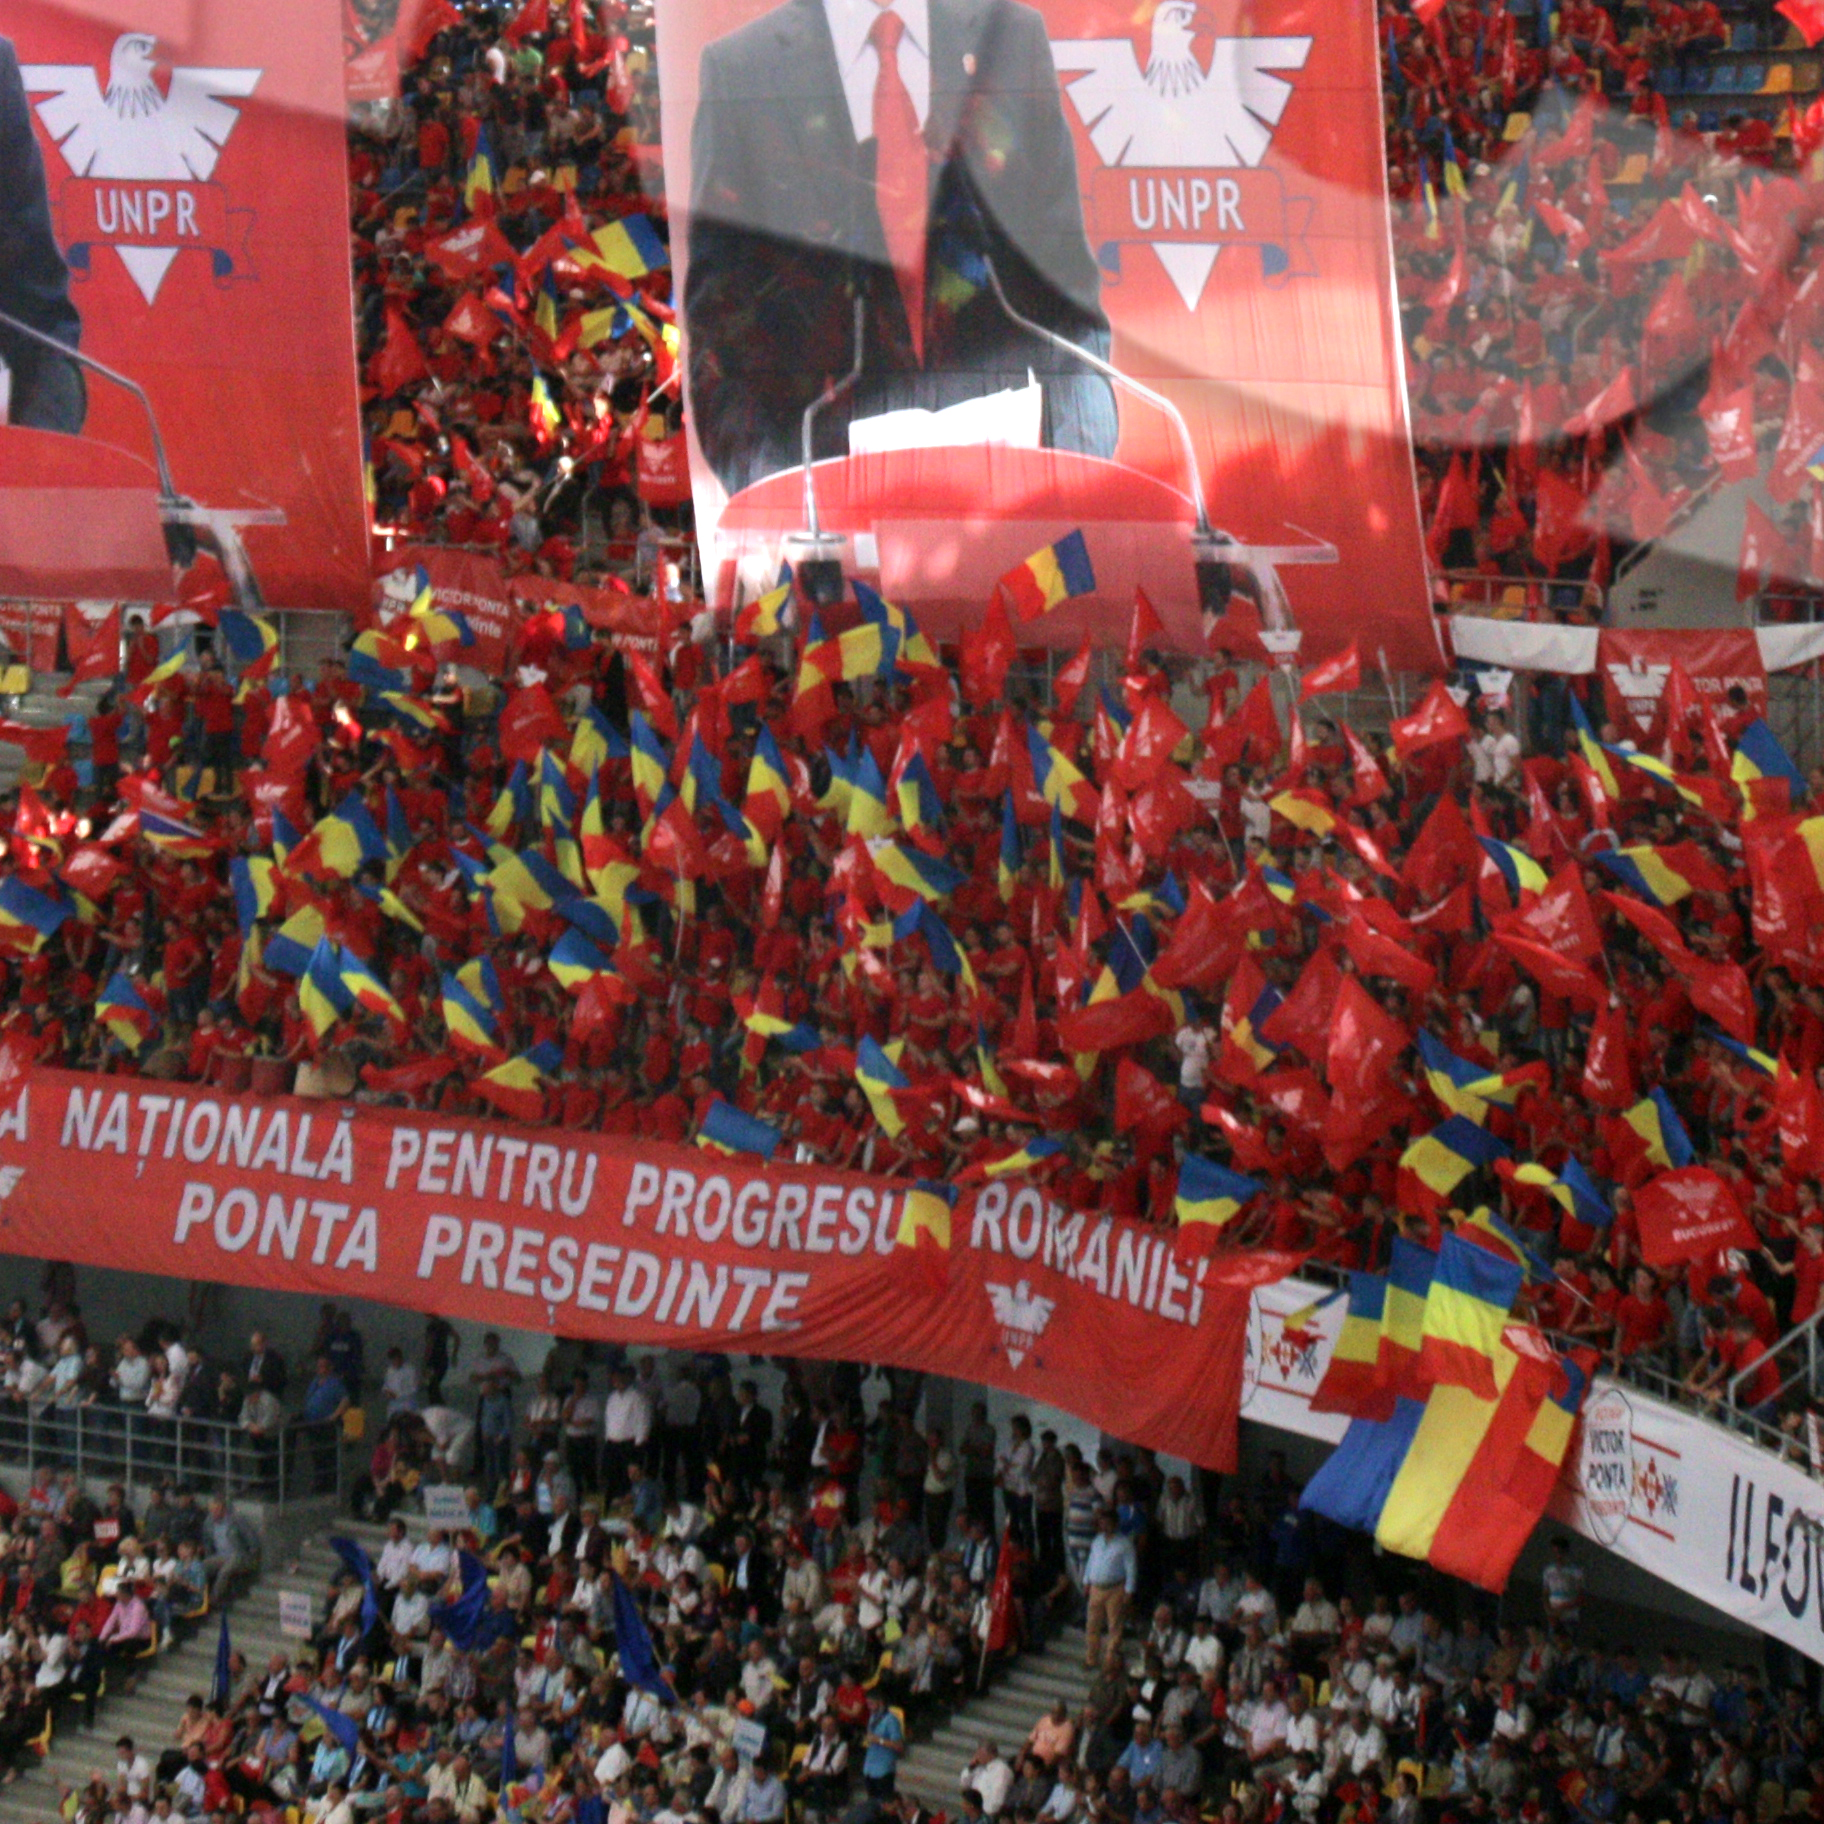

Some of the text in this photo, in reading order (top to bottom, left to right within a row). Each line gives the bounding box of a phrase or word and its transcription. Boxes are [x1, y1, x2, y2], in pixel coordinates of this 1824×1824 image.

[94, 189, 199, 237] UNPR
[1129, 177, 1245, 232] UNPR
[61, 1086, 356, 1186] NAȚIONALĂ
[384, 1127, 598, 1218] PENTRU
[623, 1161, 906, 1257] PROGRESU
[174, 1181, 812, 1332] PONTA PREȘEDINTE
